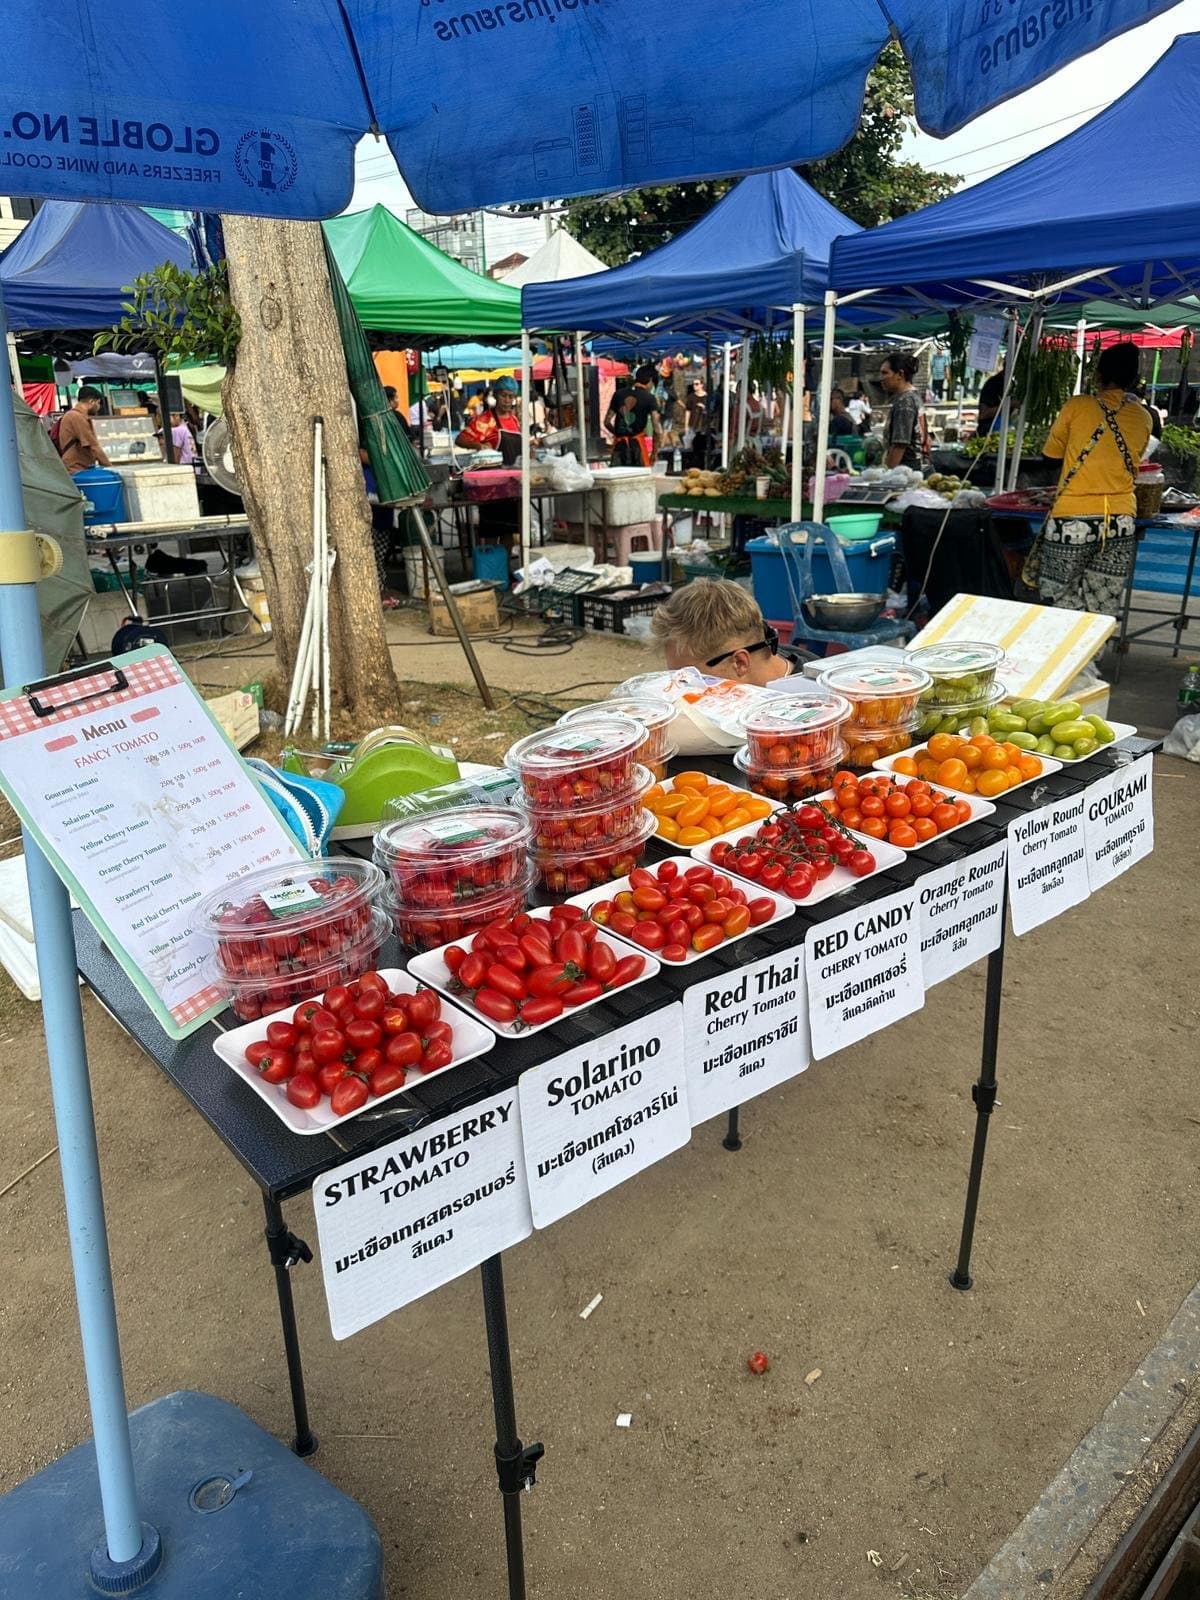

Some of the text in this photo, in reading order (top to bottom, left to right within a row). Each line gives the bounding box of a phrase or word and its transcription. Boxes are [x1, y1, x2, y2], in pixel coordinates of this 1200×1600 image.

[74, 731, 159, 768] FANCY TOMATO
[81, 719, 128, 741] Menu
[44, 786, 74, 801] Gourami
[73, 777, 99, 790] Tomato
[1088, 774, 1147, 821] GOURAMI
[62, 813, 91, 827] Solarino
[90, 802, 115, 816] Tomato
[1014, 798, 1085, 843] Yellow Round
[1104, 801, 1134, 827] TOMATO
[80, 839, 104, 853] Yellow
[103, 829, 126, 843] Cherry
[125, 818, 149, 833] Tomato
[1022, 824, 1077, 856] Cherry Tomato
[98, 862, 123, 877] Orange
[122, 852, 145, 866] Cherry
[143, 841, 167, 857] Tomato
[920, 851, 1005, 904] Orange Round
[115, 884, 150, 904] Strawberry
[149, 872, 173, 887] Tomato
[929, 880, 993, 917] Cherry Tomato
[131, 919, 145, 931] Red
[144, 911, 159, 923] Thai
[158, 902, 180, 919] Cherry
[179, 891, 202, 906] Tomato
[814, 902, 914, 960] RED CANDY
[149, 942, 170, 957] Yellow
[169, 934, 184, 946] Thai
[821, 932, 908, 979] CHERRY TOMATO
[166, 972, 178, 983] Red
[177, 961, 197, 975] Candy
[705, 957, 799, 1016] Red Thai
[825, 953, 907, 1010] มะเขือเทศเชอรี่
[707, 990, 796, 1035] Cherry Tomato
[703, 1016, 798, 1074] มะเขือเทศราชินี
[547, 1037, 661, 1107] Solarino
[738, 1058, 765, 1078] สีแดง
[571, 1070, 642, 1115] TOMATO
[537, 1086, 678, 1177] มะเขือเทศโซลาริโน่
[325, 1101, 513, 1207] STRAWBERRY
[592, 1138, 635, 1174] (สีแดง)
[380, 1151, 470, 1204] TOMATO
[335, 1161, 516, 1274] มะเขือเทศสตรอเบอรี่
[411, 1229, 453, 1259] สีแดง
